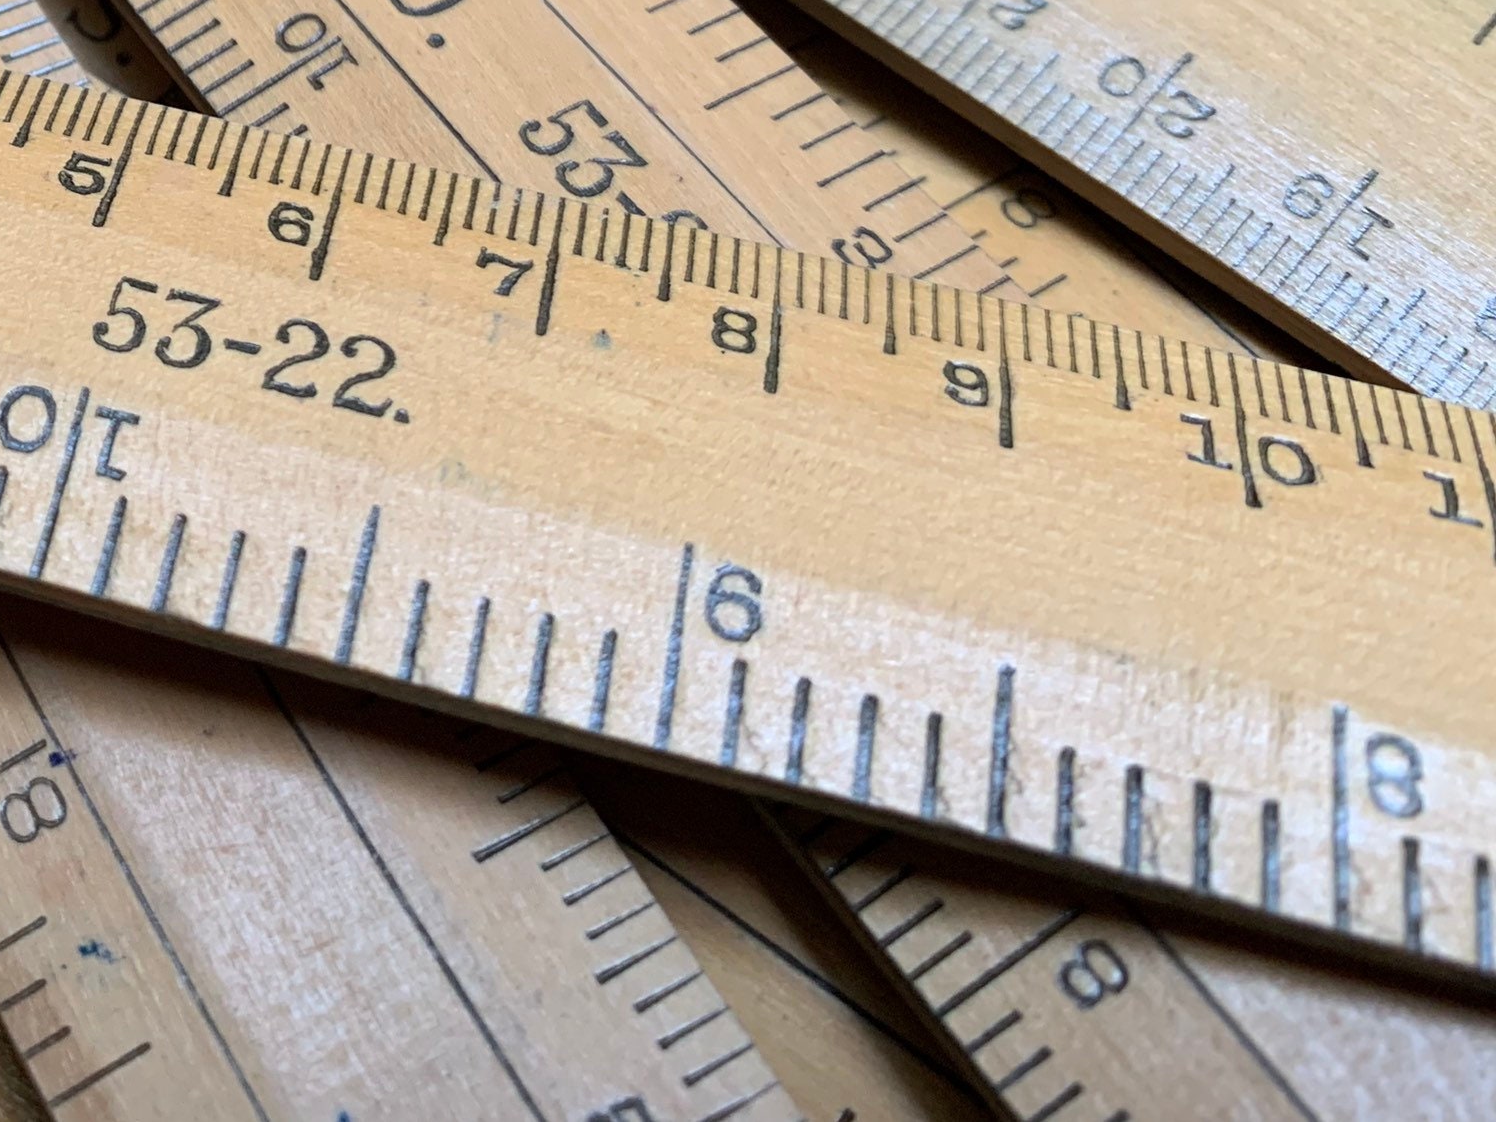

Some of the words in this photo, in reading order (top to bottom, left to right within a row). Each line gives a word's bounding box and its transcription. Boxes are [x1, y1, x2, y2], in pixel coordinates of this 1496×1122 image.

[275, 12, 360, 91] 10
[1096, 56, 1217, 139] 20
[57, 151, 113, 195] 5
[266, 201, 315, 246] 6
[1282, 172, 1394, 262] 19
[476, 246, 534, 297] 7
[92, 276, 411, 424] 53-22.
[711, 306, 758, 354] 8
[942, 360, 989, 407] 9
[1179, 413, 1318, 486] 10
[0, 776, 67, 844] 8
[1363, 733, 1424, 818] 8
[1056, 938, 1129, 1010] 8
